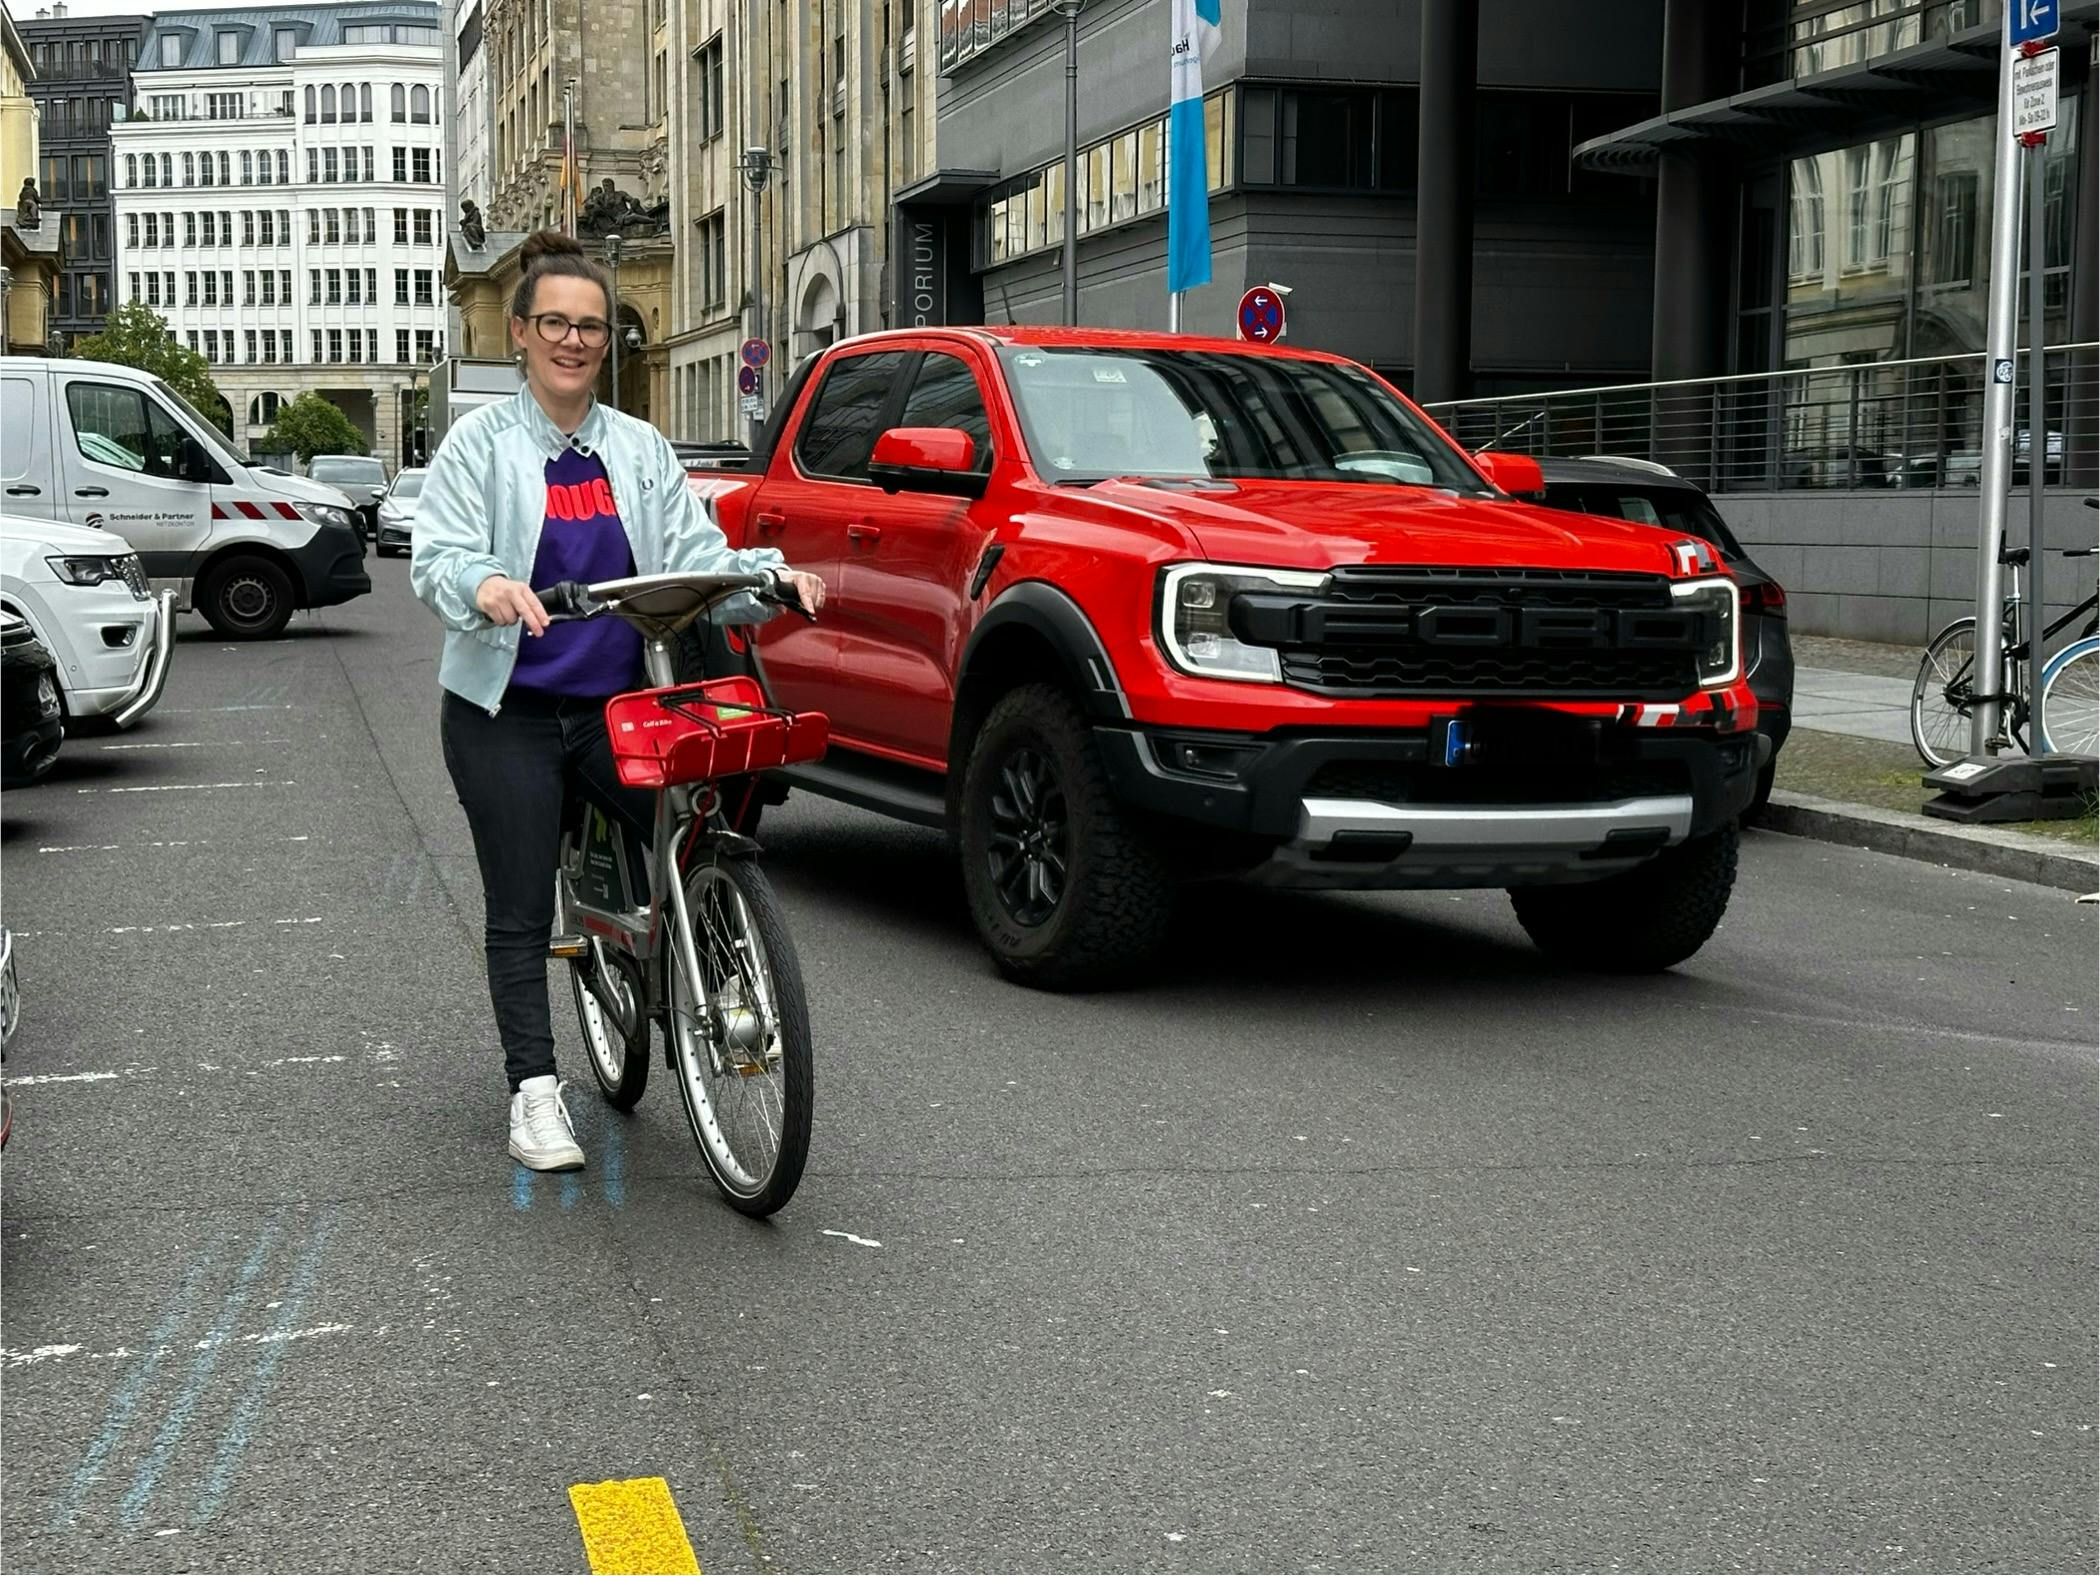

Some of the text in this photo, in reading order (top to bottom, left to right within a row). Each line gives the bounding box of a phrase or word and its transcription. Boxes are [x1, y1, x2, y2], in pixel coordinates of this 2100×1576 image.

[109, 513, 194, 521] Schneider & Partner
[1303, 602, 1702, 650] FORD
